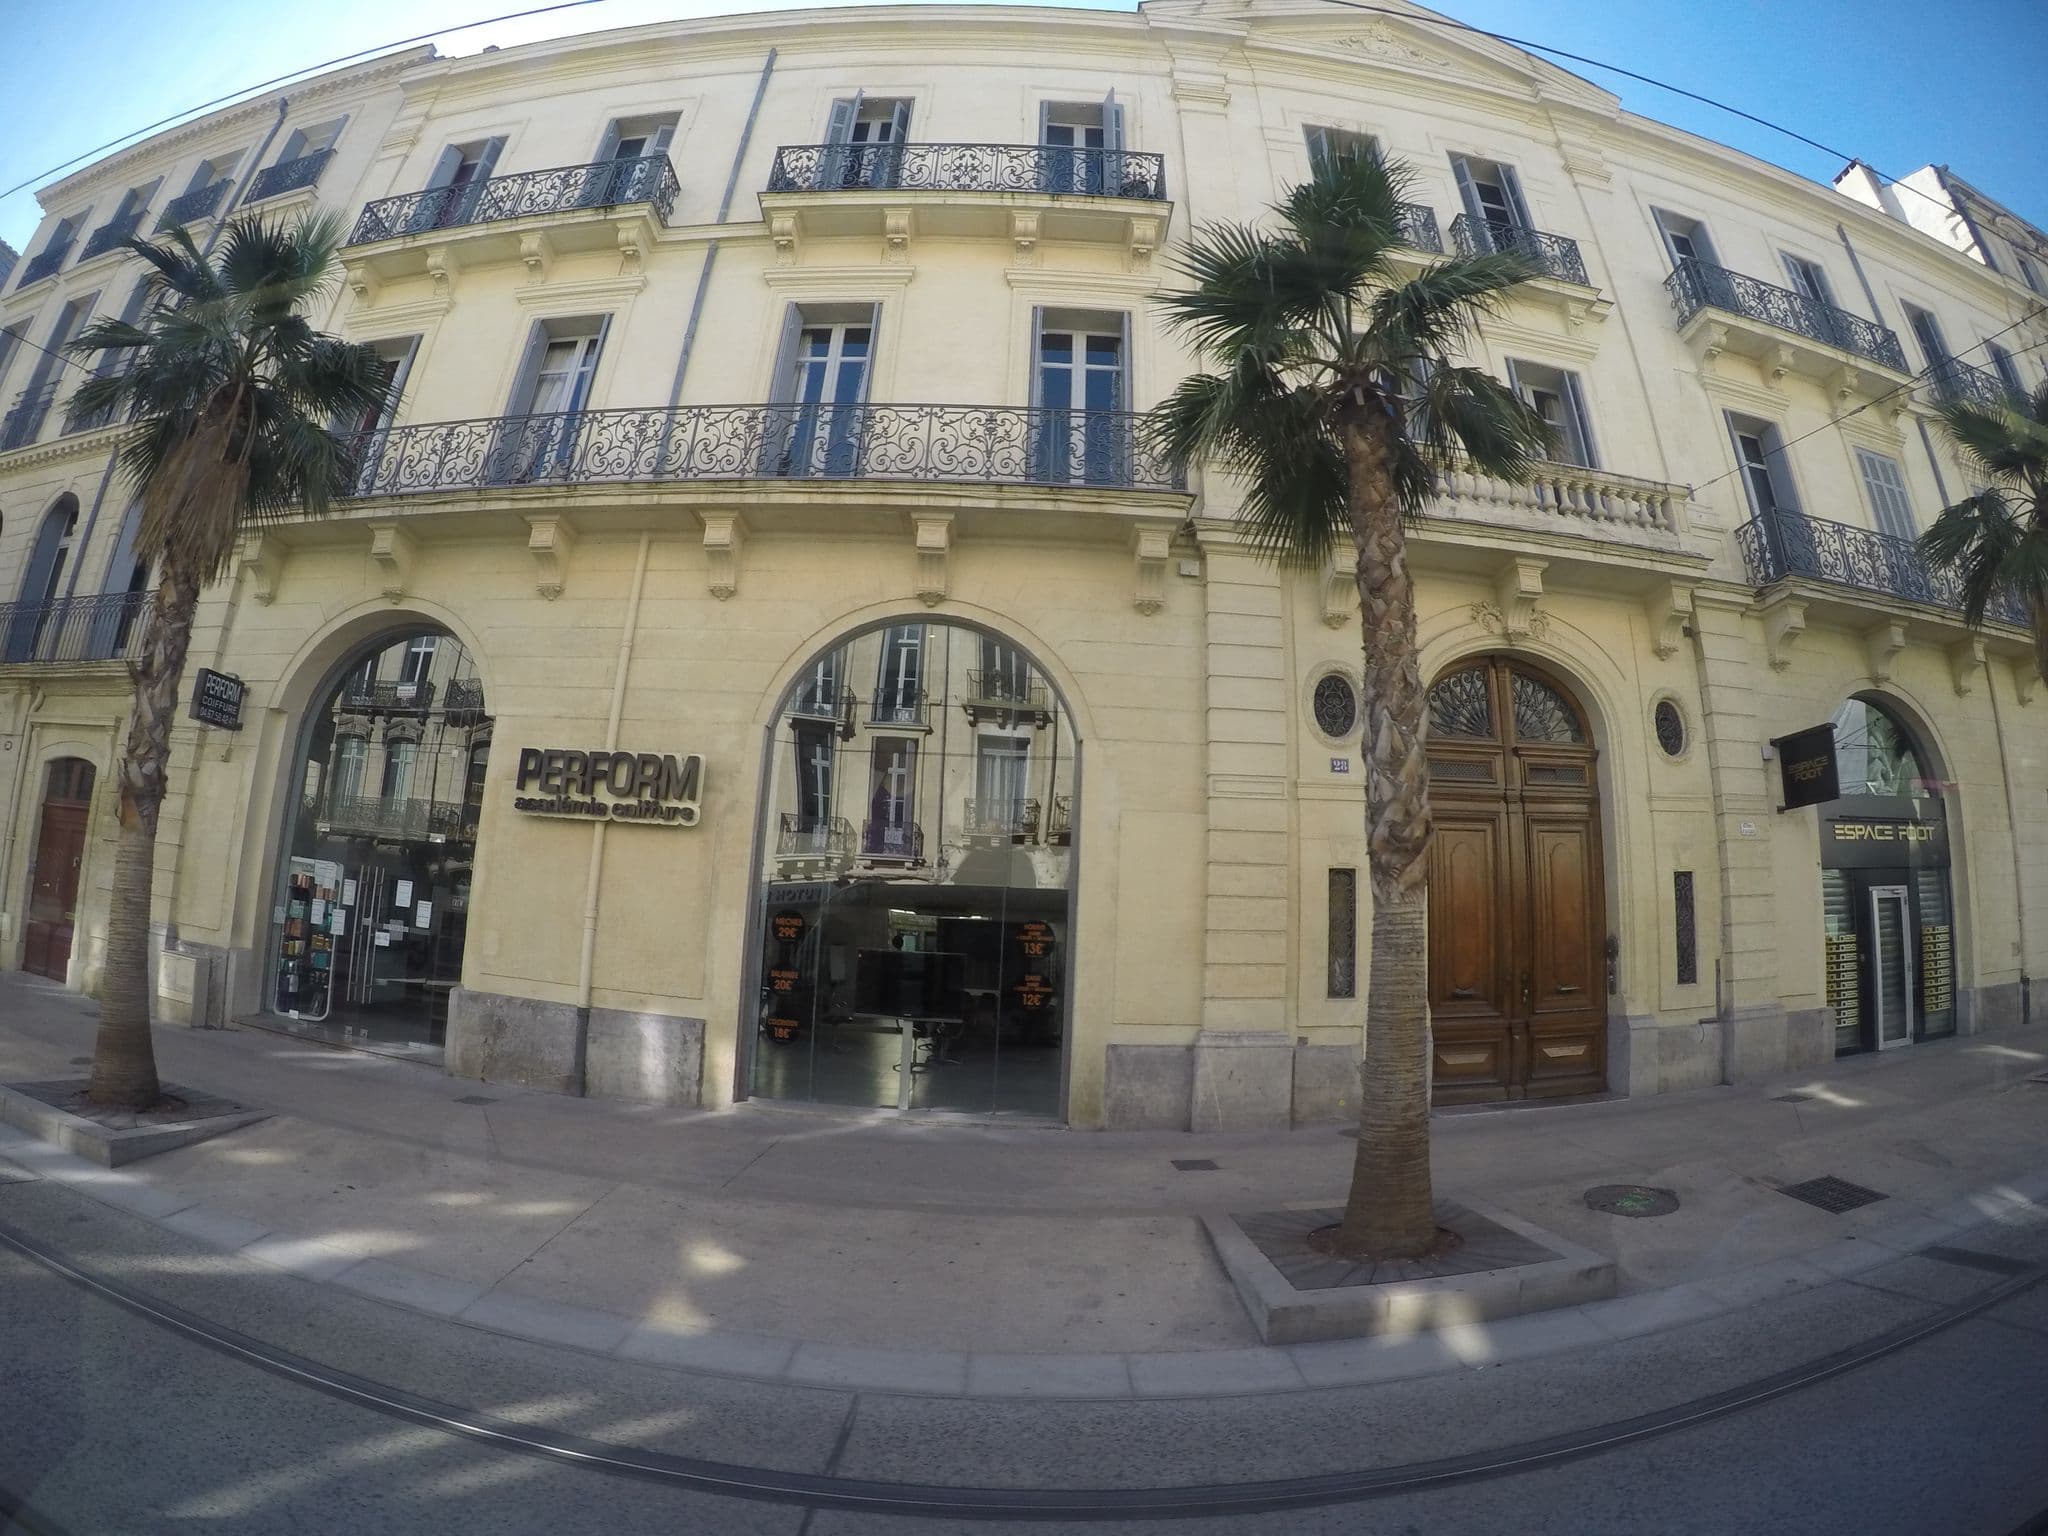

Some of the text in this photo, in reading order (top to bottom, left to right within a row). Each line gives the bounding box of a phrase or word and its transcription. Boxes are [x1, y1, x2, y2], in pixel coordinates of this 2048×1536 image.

[206, 674, 241, 702] PERFORM
[202, 696, 238, 714] COIFFURE
[516, 748, 701, 801] PERFORM
[1788, 755, 1829, 775] ESPACE
[1794, 766, 1824, 783] FOOT
[611, 800, 694, 822] coiffure
[1833, 824, 1935, 841] ESPACE FOOT
